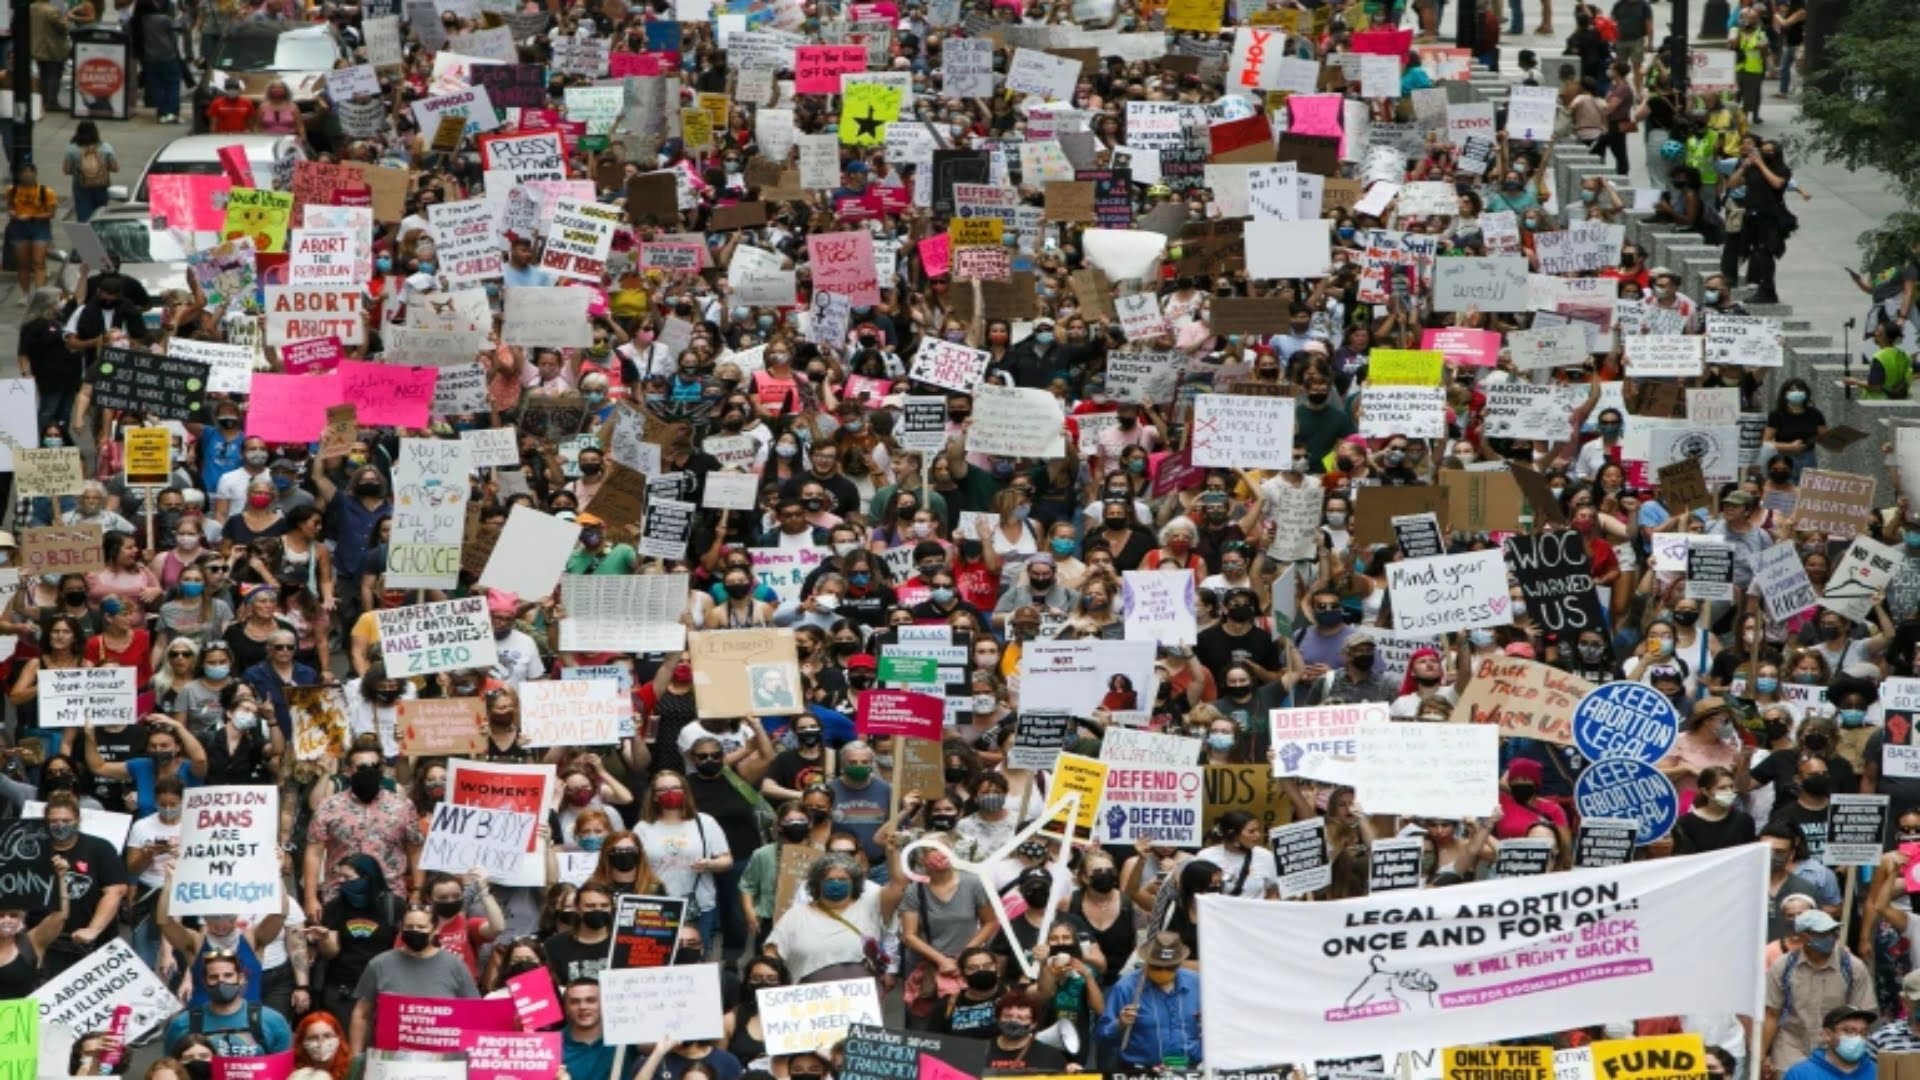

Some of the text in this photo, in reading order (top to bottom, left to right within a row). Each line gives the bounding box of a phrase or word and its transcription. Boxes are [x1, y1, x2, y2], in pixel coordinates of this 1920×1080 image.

[1241, 28, 1272, 87] VOTE
[491, 139, 558, 158] PUSSY
[299, 237, 349, 253] ABORT
[312, 254, 331, 264] THE
[275, 292, 360, 312] ABORT
[286, 318, 356, 338] ABBOTT
[1110, 352, 1168, 362] ABORTION
[1109, 363, 1151, 373] JUSTICE
[1109, 374, 1138, 383] NOW
[1489, 383, 1550, 394] ABORTION
[1378, 412, 1412, 421] TEXAS
[408, 443, 459, 460] YOU DO
[419, 460, 450, 478] YOU
[1801, 475, 1870, 496] PROTECT
[433, 515, 455, 530] DO
[1796, 517, 1856, 537] ACCESS
[413, 529, 439, 543] ME
[29, 545, 100, 566] OBJECT
[389, 545, 459, 573] CHOICE
[885, 549, 910, 564] MY
[1507, 529, 1587, 569] WOC
[1392, 560, 1488, 590] Mind your
[1522, 573, 1594, 597] WARNED
[1424, 584, 1474, 605] own
[379, 605, 434, 624] NUMBER
[451, 599, 482, 615] LAWS
[1400, 603, 1491, 630] business
[1540, 595, 1588, 630] US
[382, 615, 474, 638] THAT CONTROL
[385, 621, 490, 653] MALE BODIES?
[408, 646, 470, 672] ZERO
[884, 648, 921, 657] Where
[1053, 656, 1073, 664] NOT
[54, 671, 81, 679] YOUR
[52, 681, 81, 692] YOUR
[536, 682, 588, 701] STAND
[67, 698, 83, 706] MY
[568, 700, 613, 716] TEXAS
[1608, 686, 1670, 717] KEEP
[57, 708, 78, 721] MY
[1276, 708, 1360, 729] DEFEND
[1580, 695, 1674, 748] ABORTION
[529, 719, 609, 745] WOMEN
[1319, 726, 1355, 738] RIGHT
[1580, 720, 1652, 760] LEGAL
[1107, 770, 1178, 790] DEFEND
[1205, 768, 1255, 805] NDS
[1584, 761, 1641, 792] KEEP
[460, 780, 539, 797] WOMEN'S
[1580, 773, 1670, 818] ABORTION
[187, 791, 268, 809] ABORTION
[197, 809, 253, 829] BANS
[431, 805, 534, 844] MY BODY
[1128, 807, 1195, 826] DEFEND
[209, 829, 241, 841] ARE
[1128, 827, 1193, 841] DEMOCRACY
[184, 843, 260, 859] AGAINST
[208, 860, 237, 876] MY
[1346, 881, 1619, 928] LEGAL ABORTION
[1322, 913, 1564, 957] ONCE AND FOR
[1581, 919, 1637, 941] BACK
[1454, 935, 1640, 977] WE WILL FIGHT BACK!
[74, 966, 140, 1015] ILLINOIS
[764, 982, 871, 1008] SOMEONE YOU
[400, 1014, 437, 1025] WITH
[406, 1004, 453, 1016] STAND
[399, 1024, 462, 1037] PLANNED
[767, 1010, 873, 1036] MAY NEED A
[399, 1034, 460, 1047] PARENTH
[478, 1035, 544, 1048] PROTECT
[849, 1025, 901, 1045] Abortion
[907, 1036, 941, 1050] saves
[467, 1046, 554, 1060] SAFE, LEGAL
[845, 1039, 917, 1061] CISWOMEN
[1455, 1050, 1541, 1066] ONLY THE
[469, 1058, 549, 1070] ABORTION
[847, 1054, 918, 1079] TRANSMEN
[1603, 1049, 1695, 1078] FUND
[1451, 1069, 1547, 1080] STRUGGLE
